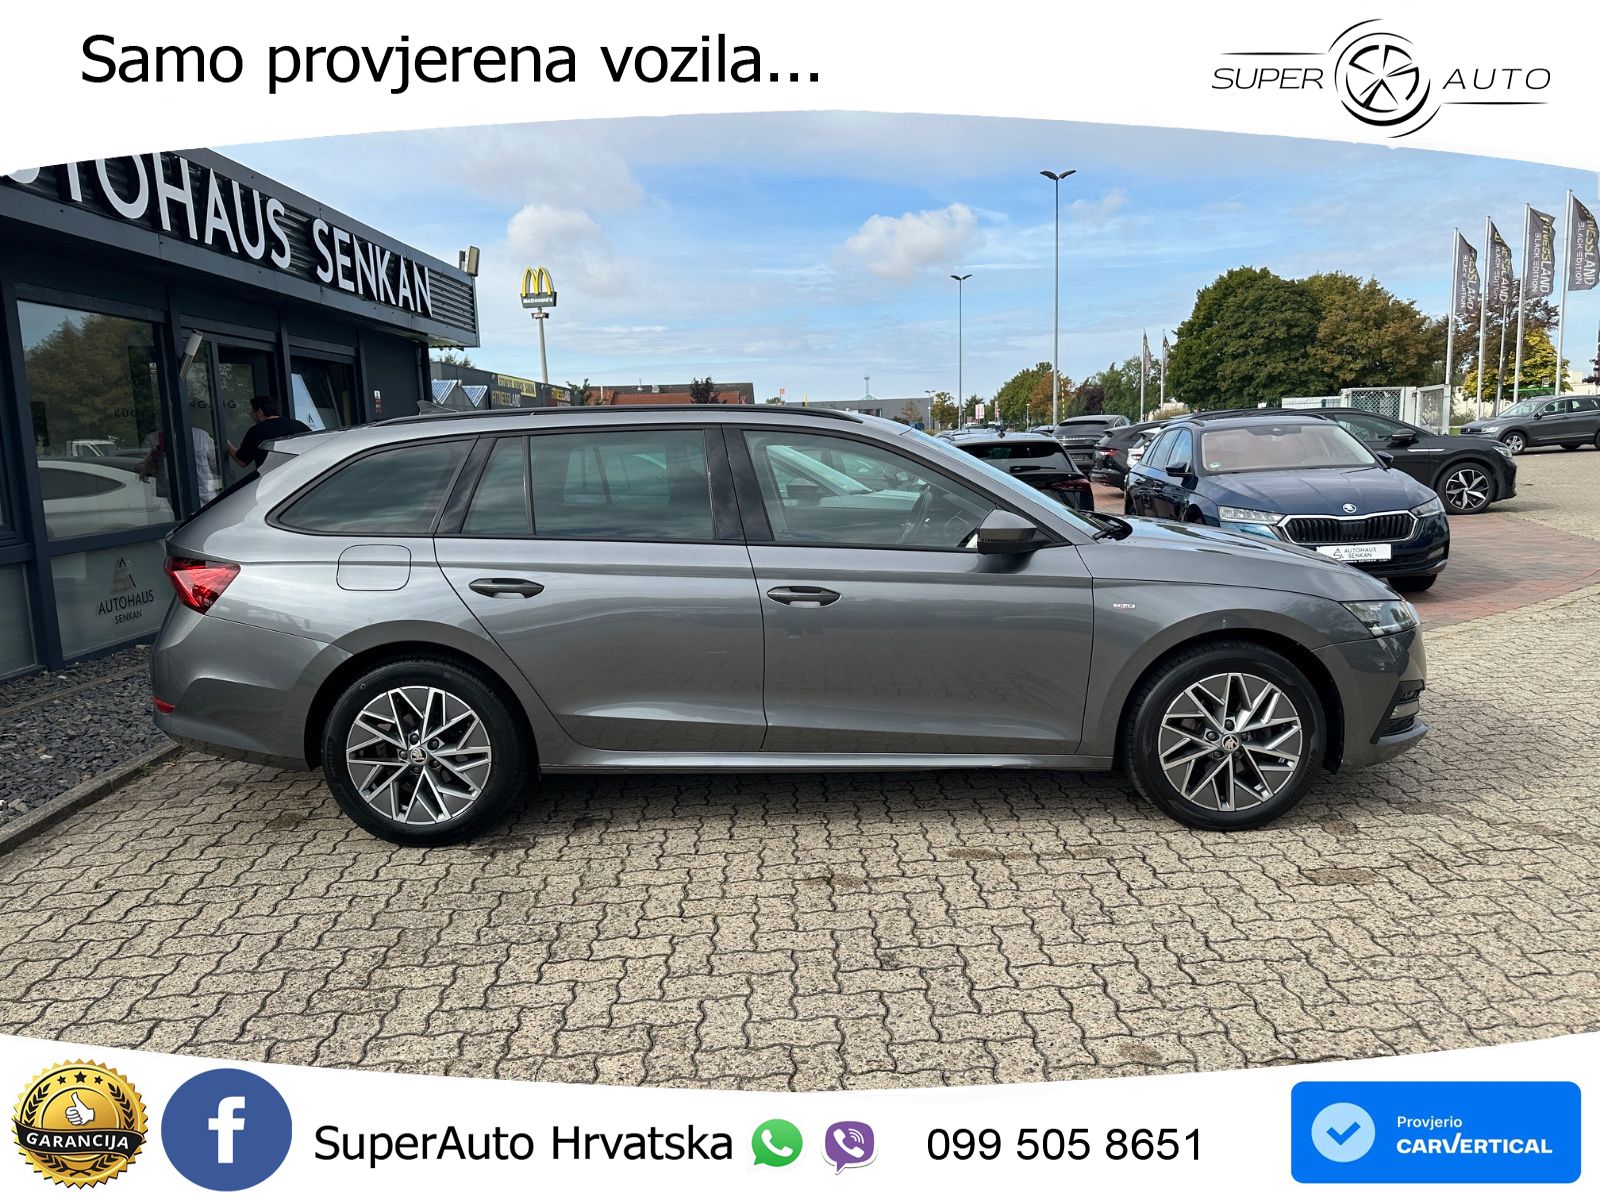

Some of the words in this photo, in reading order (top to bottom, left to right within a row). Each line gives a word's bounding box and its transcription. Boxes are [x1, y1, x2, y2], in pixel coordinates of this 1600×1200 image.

[313, 219, 432, 317] SENKAN
[98, 589, 155, 615] AUTOHAUS
[114, 610, 143, 625] SENKAN
